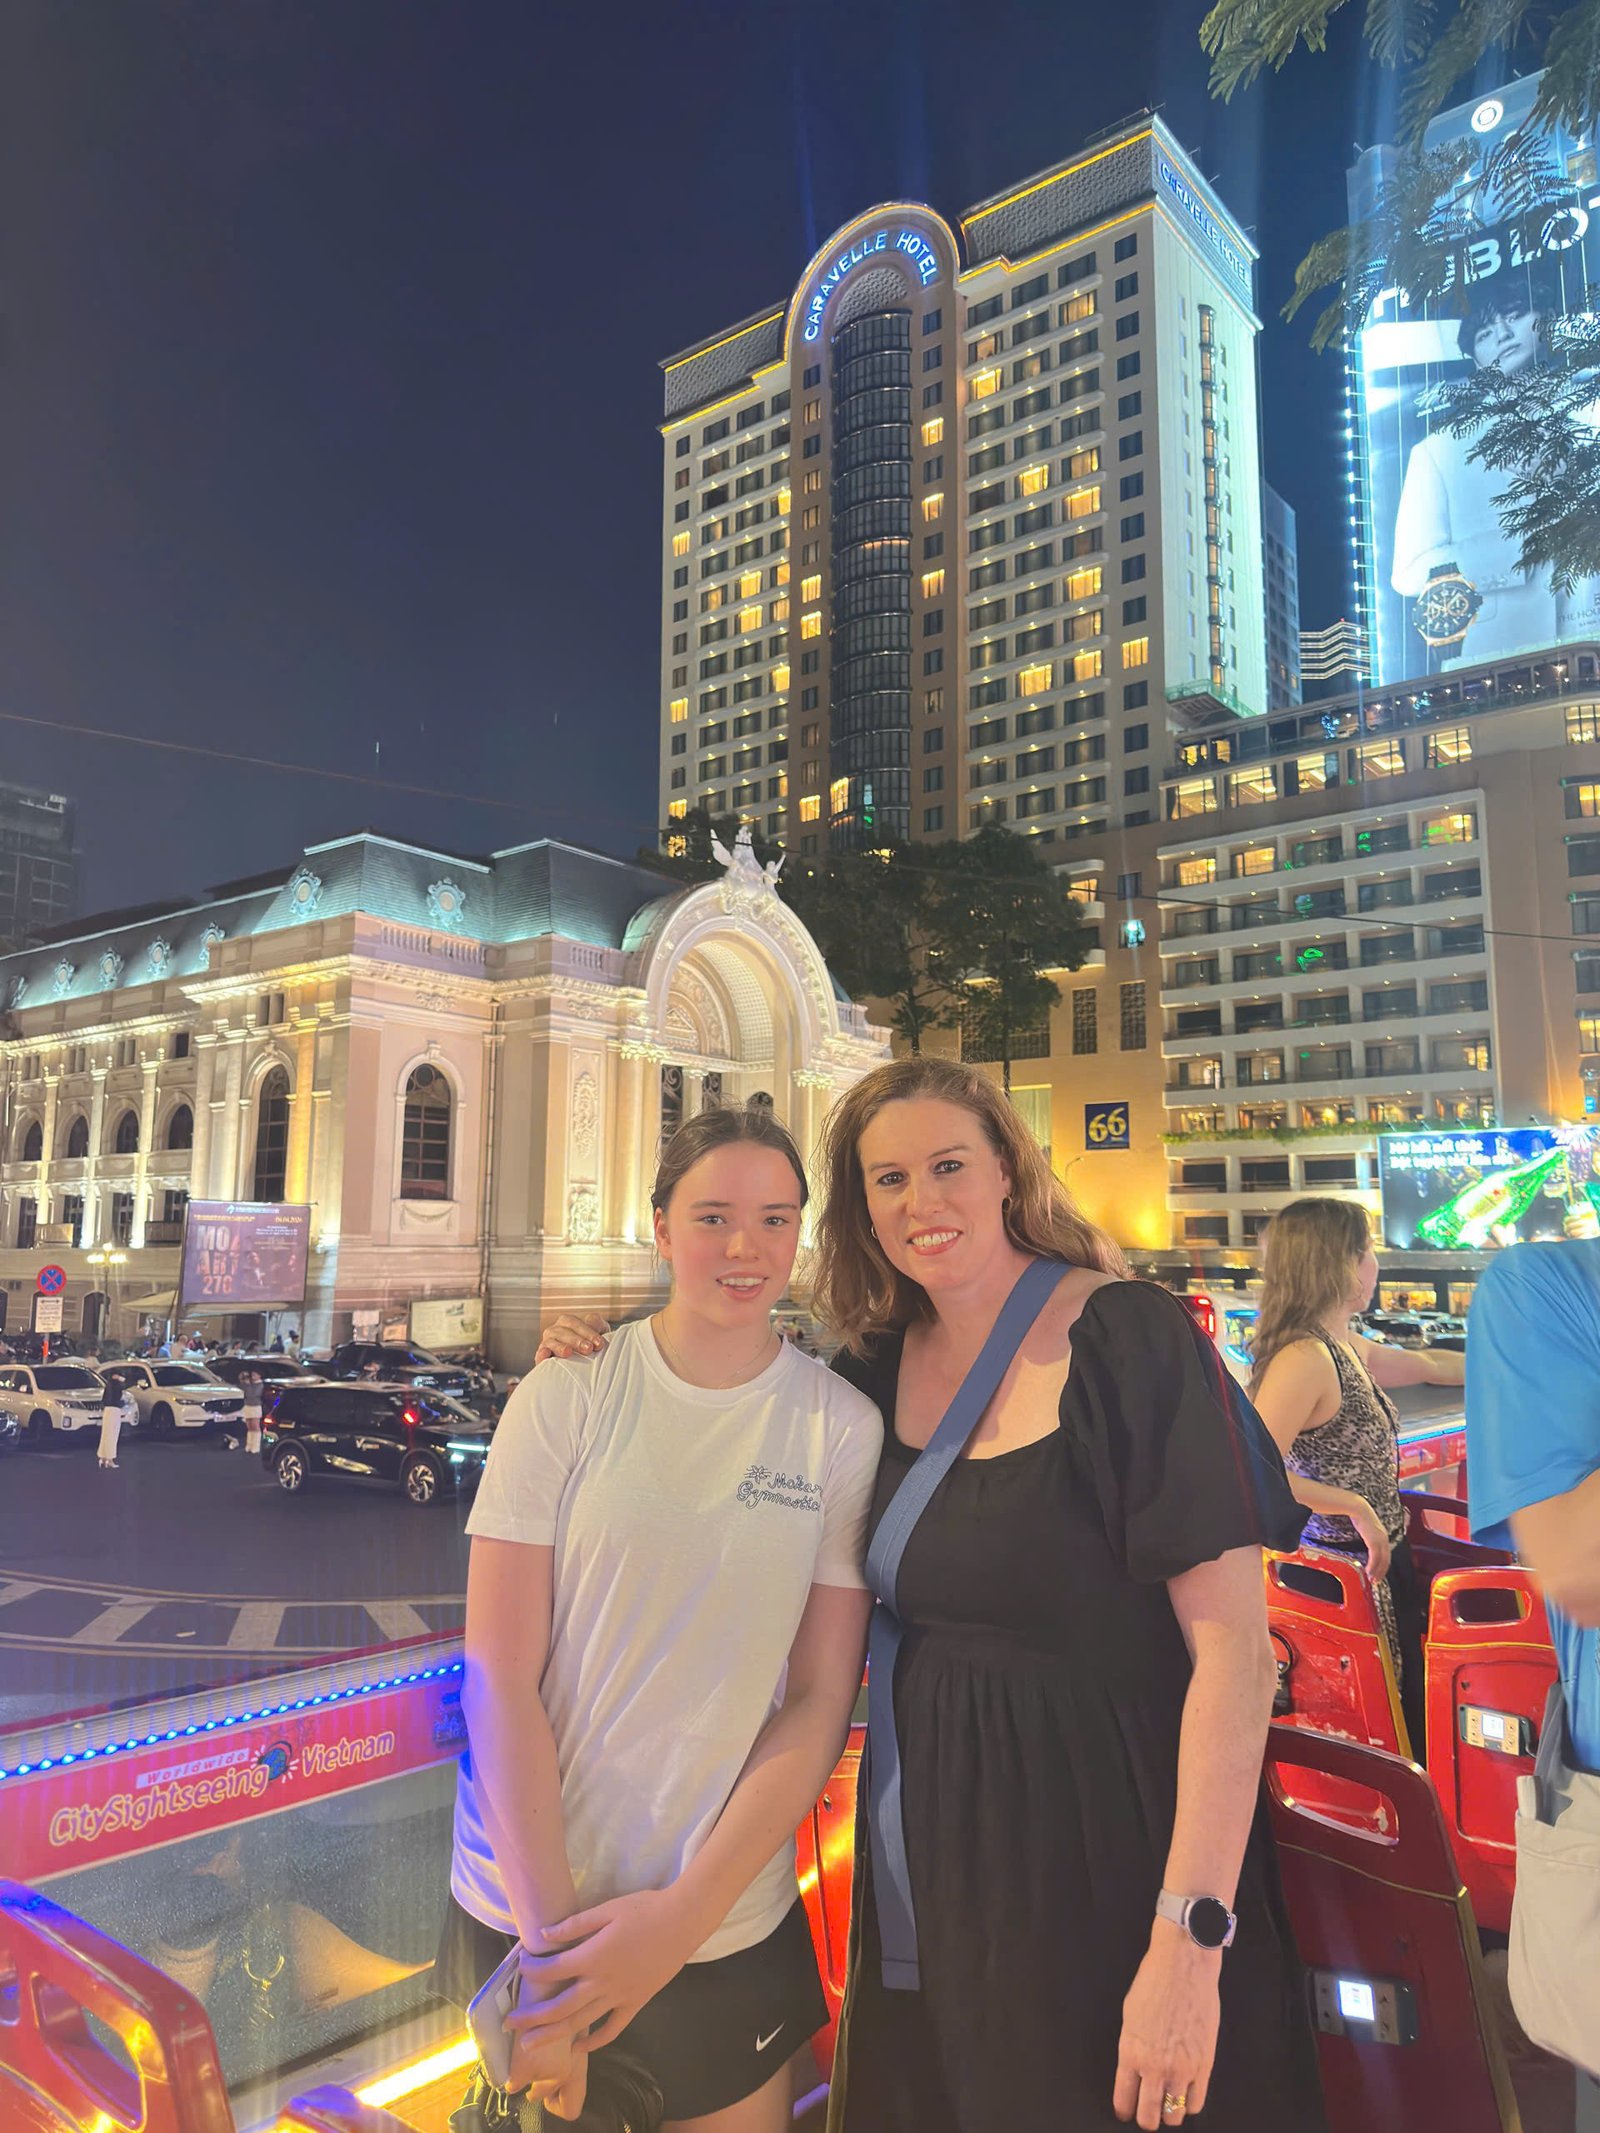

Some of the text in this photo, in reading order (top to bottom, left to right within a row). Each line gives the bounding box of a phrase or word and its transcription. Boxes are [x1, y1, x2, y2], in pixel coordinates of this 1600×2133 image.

[1161, 162, 1249, 288] CARAVELLE HOTEL
[804, 231, 937, 341] CARAVELLE HOTEL
[1088, 1107, 1126, 1143] 66
[202, 1275, 233, 1296] 270
[736, 1480, 821, 1512] Gymnastic
[146, 1750, 248, 1786] Worldwide
[50, 1731, 395, 1847] CitySightseeing Vietnam
